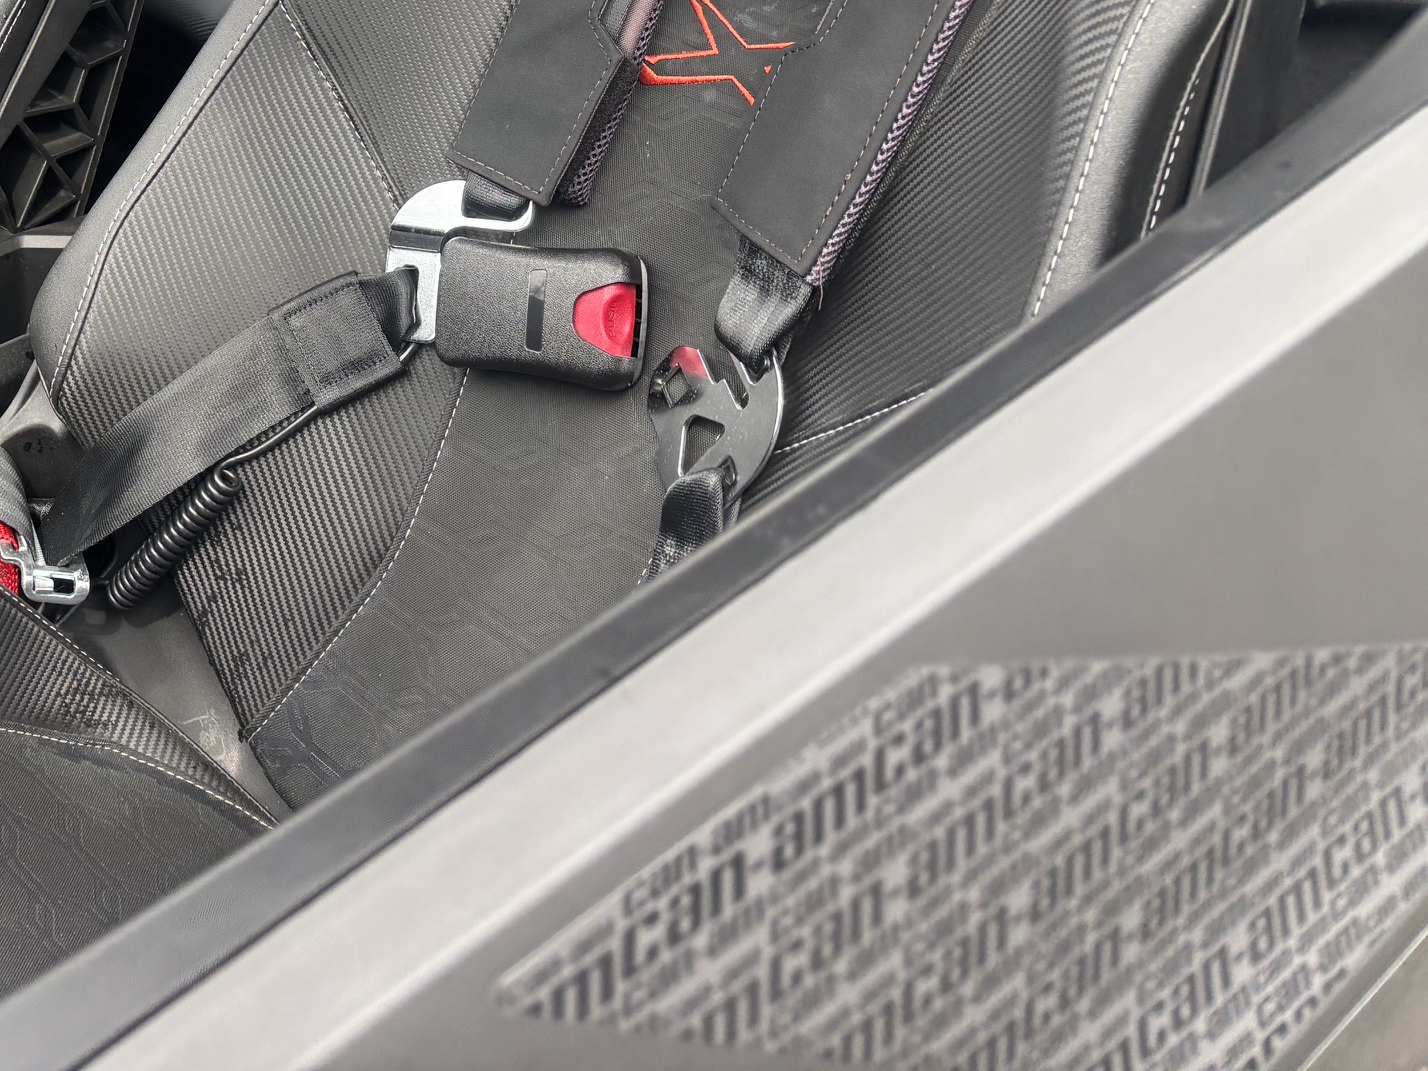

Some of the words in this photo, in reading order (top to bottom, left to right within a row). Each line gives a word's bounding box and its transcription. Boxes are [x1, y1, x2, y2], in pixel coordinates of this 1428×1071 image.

[606, 300, 619, 338] PUSH
[624, 766, 866, 978] can-am
[770, 797, 996, 1004] can-am
[1002, 661, 1200, 821] can-am
[902, 825, 1112, 1025] can-am
[1119, 667, 1298, 847] can-am
[1024, 846, 1217, 1043] can-am
[1221, 692, 1390, 869] can-am
[1139, 866, 1323, 1060] can-am
